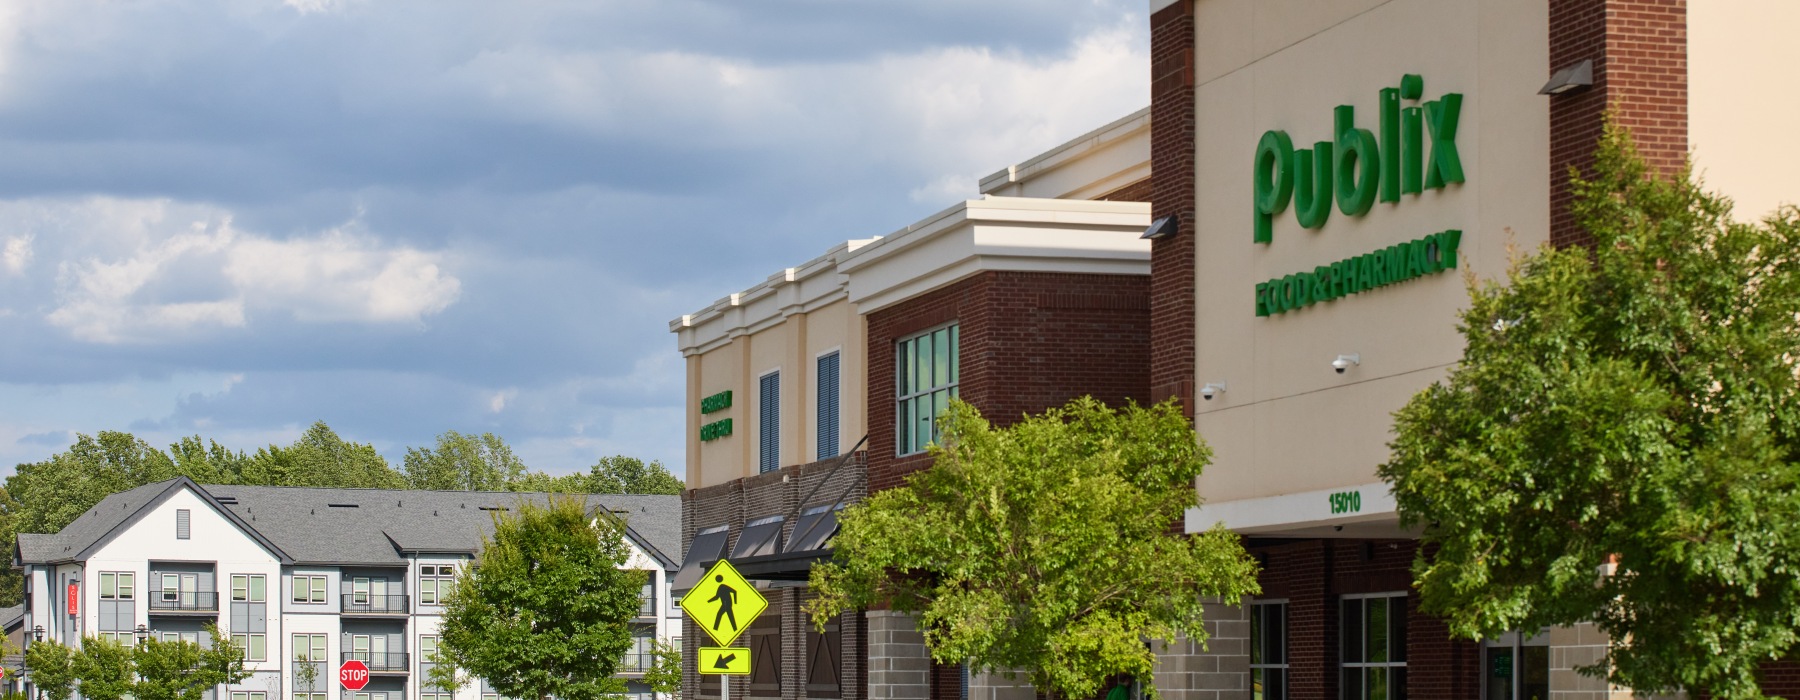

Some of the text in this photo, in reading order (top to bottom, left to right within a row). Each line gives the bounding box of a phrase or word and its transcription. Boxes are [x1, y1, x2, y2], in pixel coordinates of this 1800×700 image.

[1254, 73, 1465, 244] Publix
[1328, 490, 1361, 514] 15010
[341, 669, 367, 681] STOP
